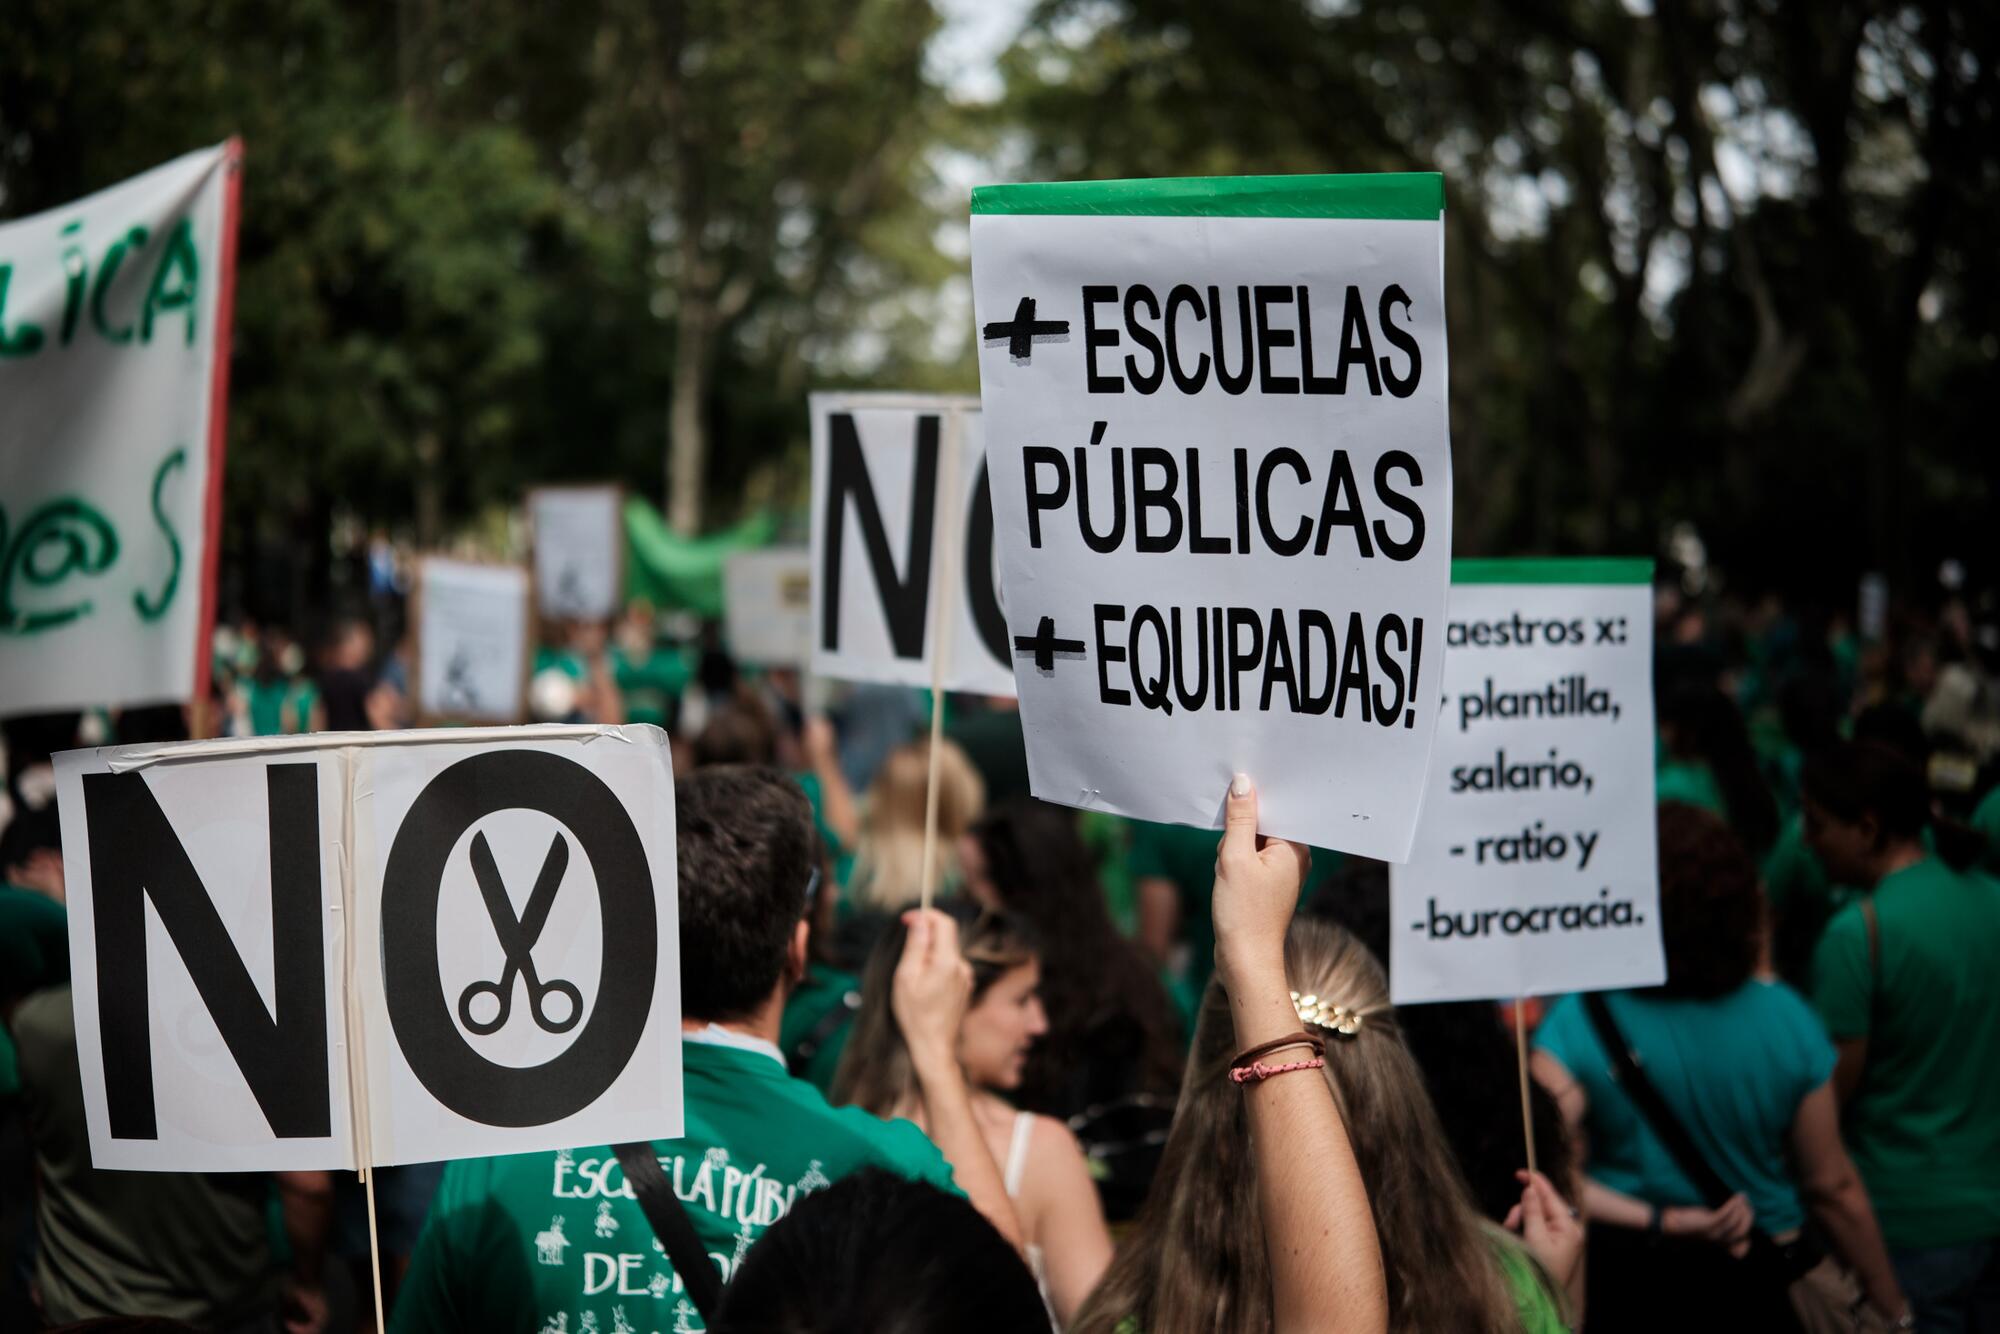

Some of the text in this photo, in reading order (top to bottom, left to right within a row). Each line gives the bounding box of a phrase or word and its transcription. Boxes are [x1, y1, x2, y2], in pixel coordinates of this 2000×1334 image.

[1082, 284, 1423, 399] ESCUELAS
[1022, 421, 1427, 562] PÚBLICAS
[0, 447, 188, 635] @S
[821, 413, 1014, 672] N
[1446, 612, 1628, 647] aestros x:
[1094, 603, 1424, 730] EQUIPADAS!
[1460, 675, 1621, 731] plantilla,
[1450, 750, 1594, 795] salario,
[1475, 821, 1568, 865] ratio
[1574, 831, 1600, 871] y
[1410, 889, 1645, 941] -burocracia.
[81, 748, 658, 1140] NO
[553, 1155, 717, 1212] ESCLA
[583, 1252, 651, 1296] DE
